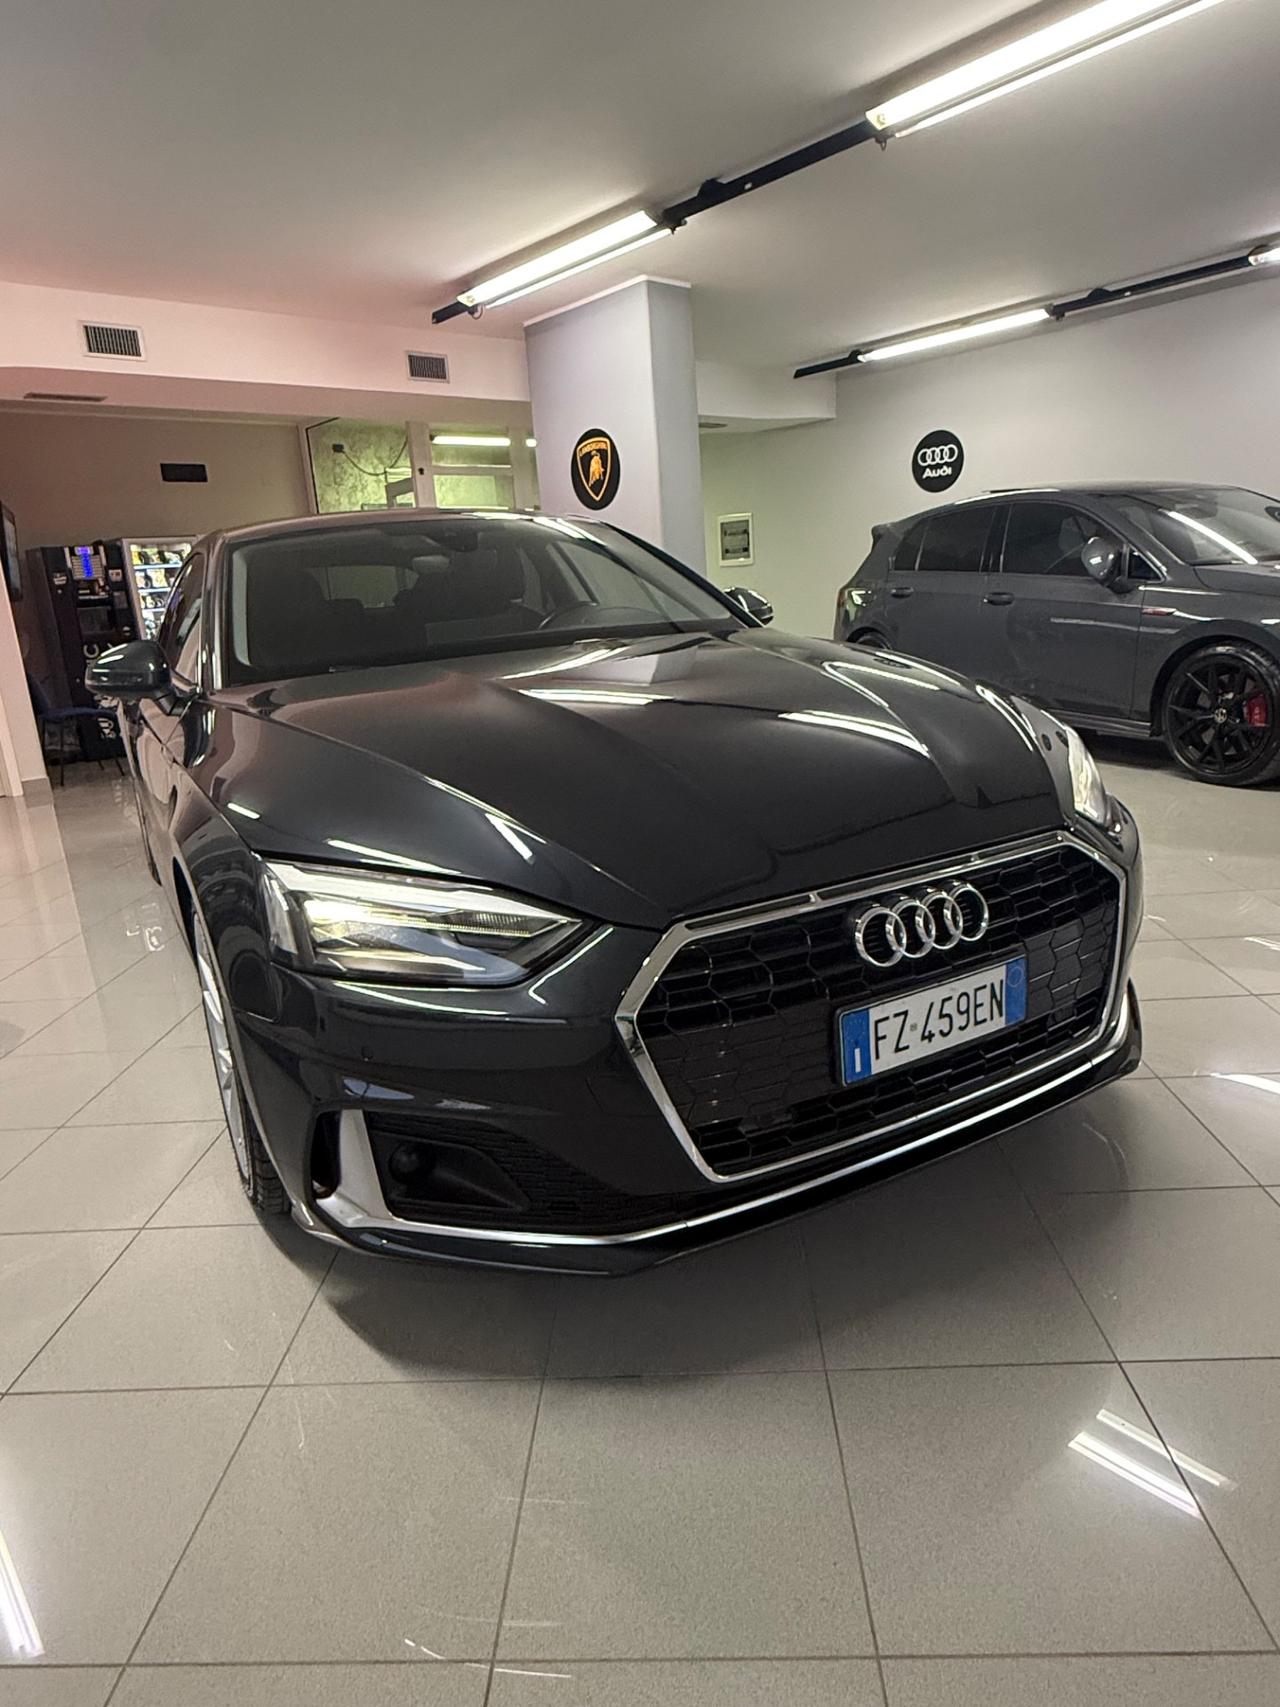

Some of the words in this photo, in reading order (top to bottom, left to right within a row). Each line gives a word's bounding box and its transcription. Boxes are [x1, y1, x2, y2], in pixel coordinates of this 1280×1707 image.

[922, 465, 952, 479] Audi
[874, 1009, 910, 1060] FZ
[920, 979, 1004, 1043] 459EN
